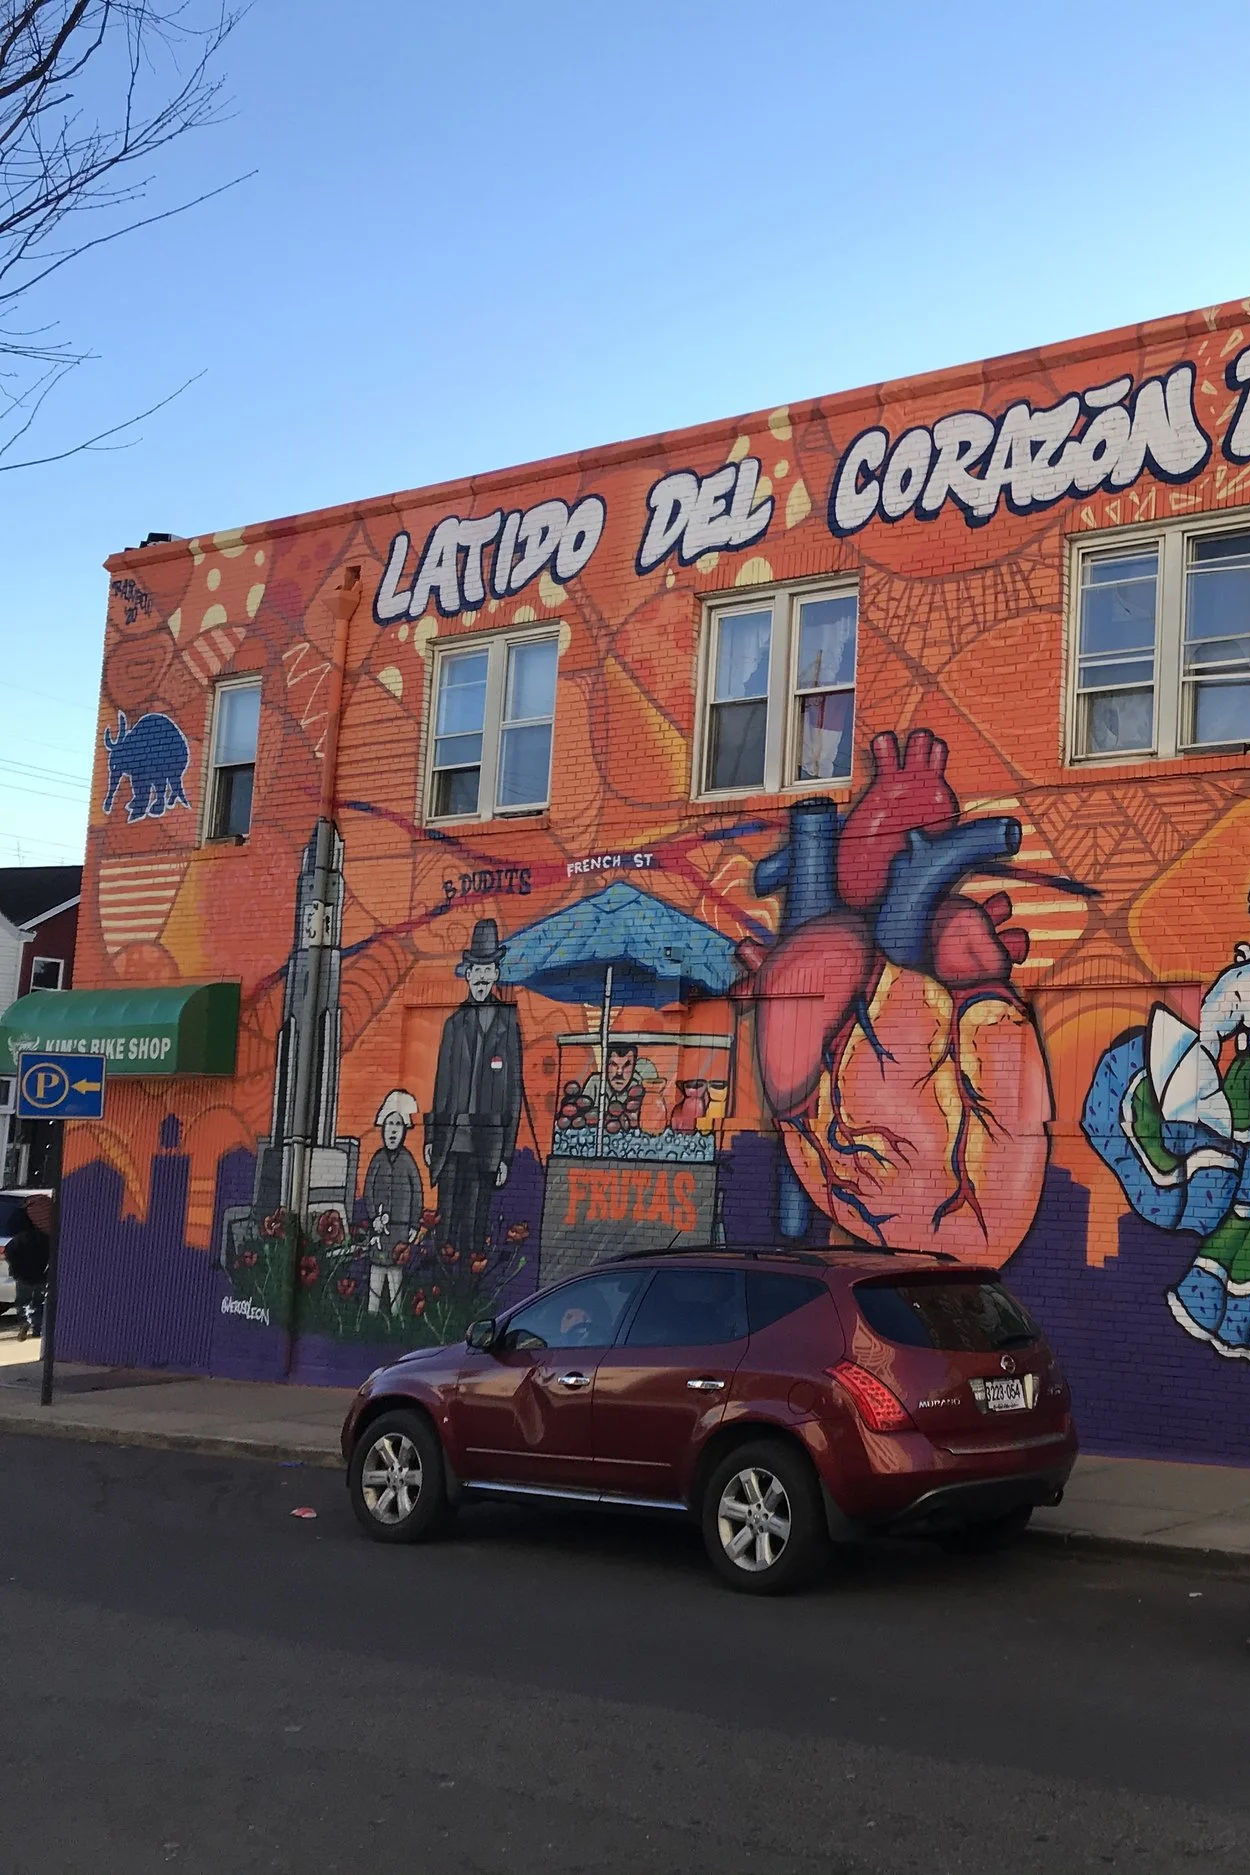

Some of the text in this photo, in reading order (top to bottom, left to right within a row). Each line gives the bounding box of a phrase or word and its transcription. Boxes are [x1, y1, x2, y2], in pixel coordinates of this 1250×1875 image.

[372, 493, 605, 626] LATIDO
[635, 456, 775, 577] DEL
[566, 853, 653, 878] FRENCH ST
[90, 1038, 125, 1060] BIKE
[128, 1037, 171, 1060] SHOP
[36, 1072, 60, 1098] P
[563, 1167, 698, 1232] FRUTAS
